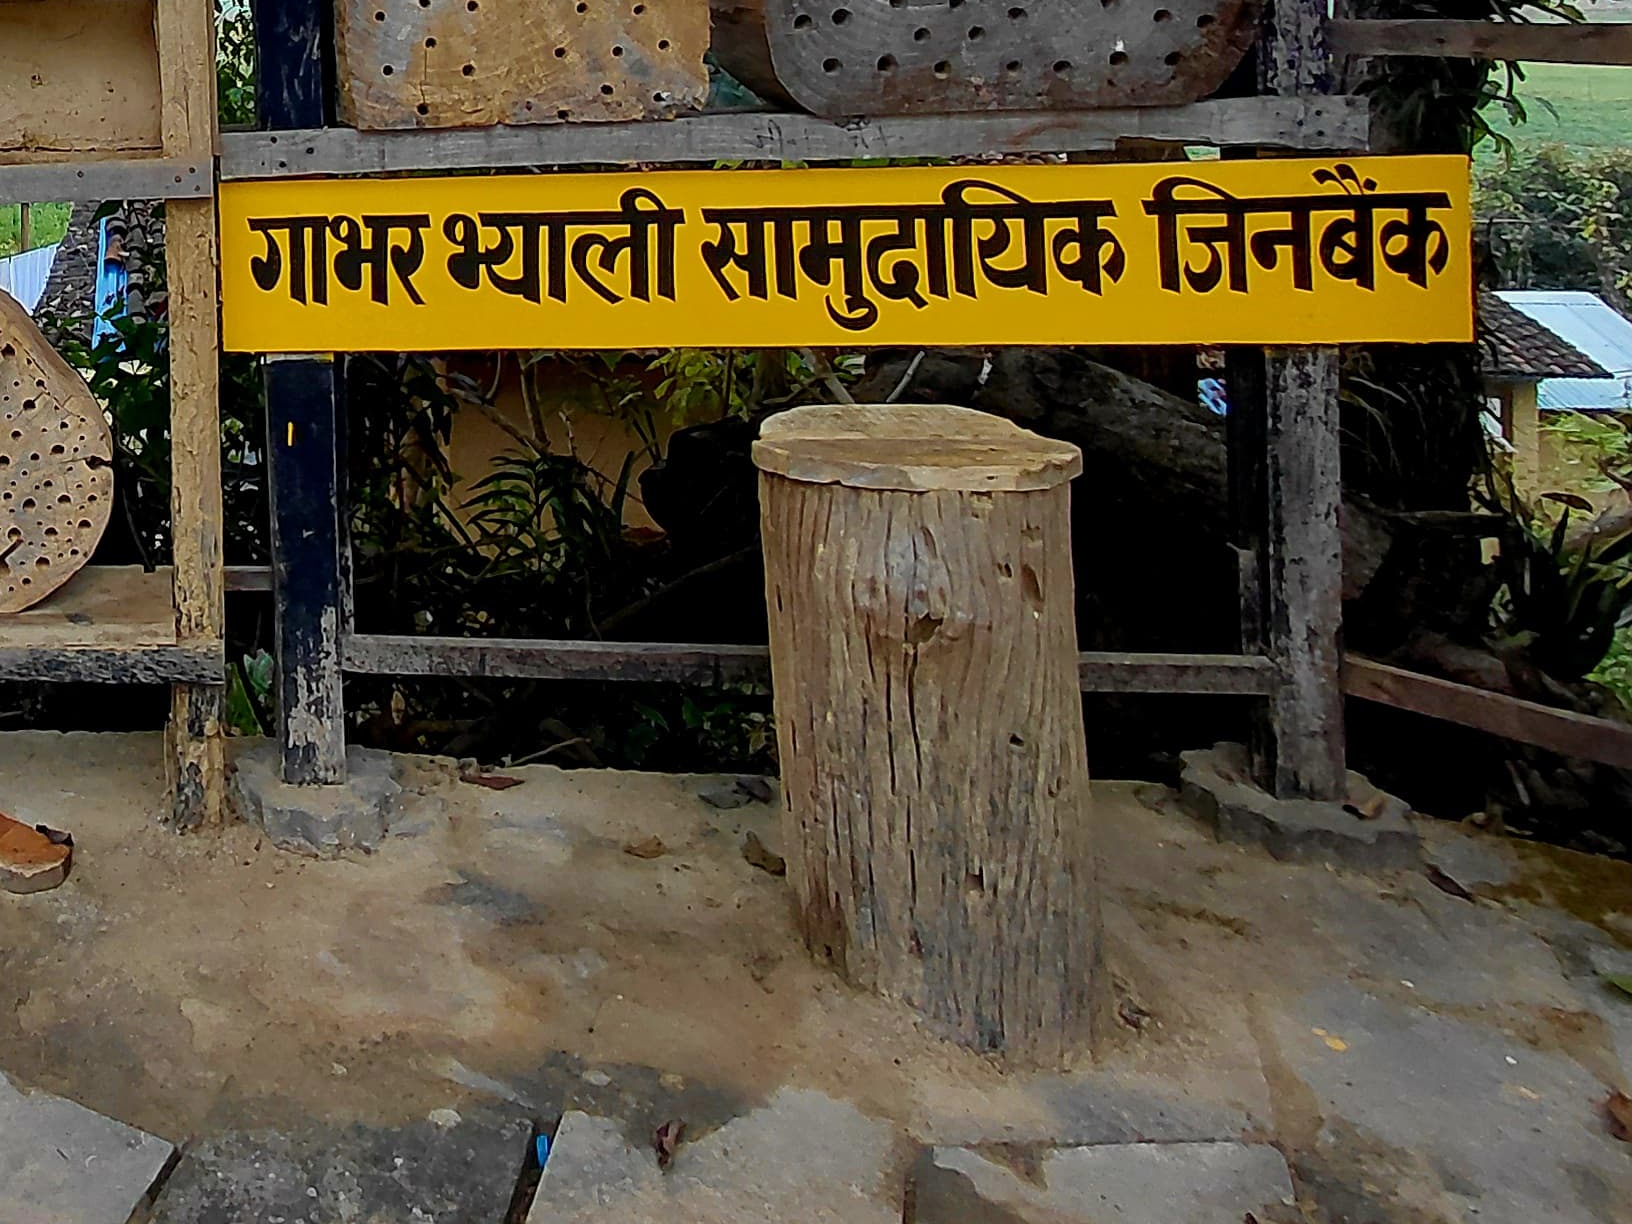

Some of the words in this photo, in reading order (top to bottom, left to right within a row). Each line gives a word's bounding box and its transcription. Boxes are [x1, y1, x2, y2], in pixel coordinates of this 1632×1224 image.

[245, 212, 432, 307] गाभर
[441, 186, 687, 306] भ्याली
[700, 178, 1127, 332] सामुदायिक
[1139, 162, 1454, 295] जिनबैंक
